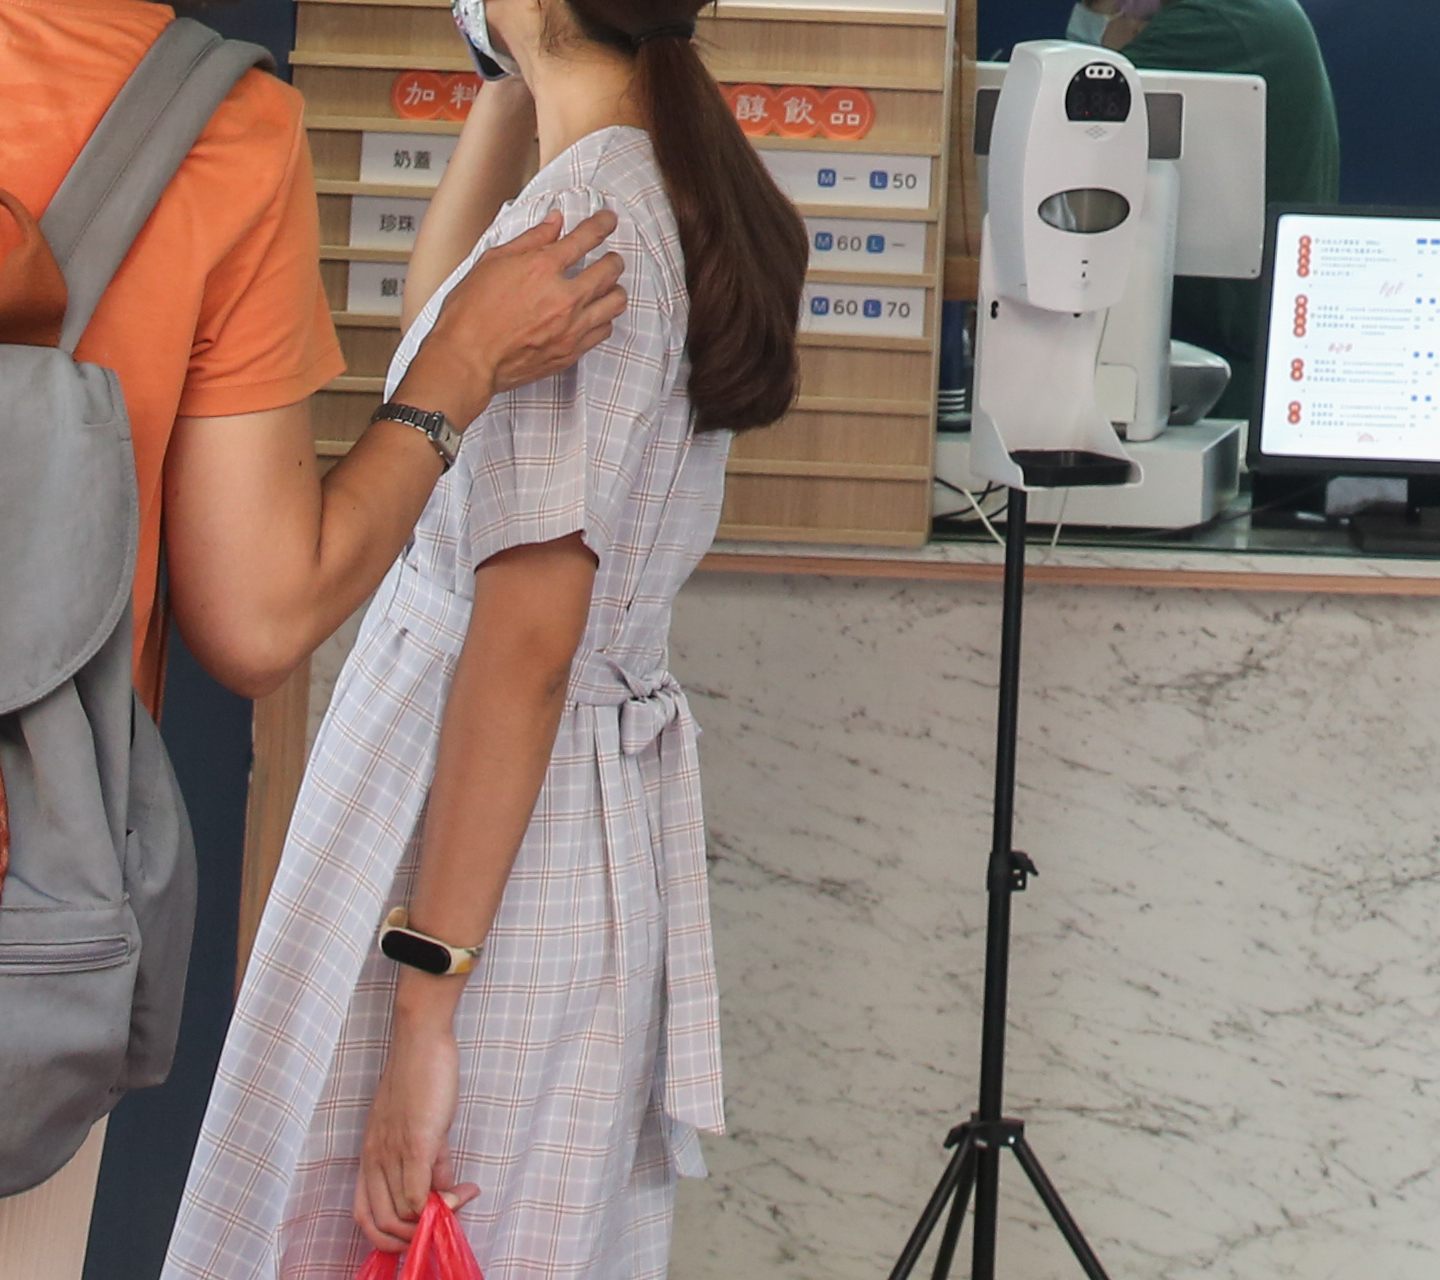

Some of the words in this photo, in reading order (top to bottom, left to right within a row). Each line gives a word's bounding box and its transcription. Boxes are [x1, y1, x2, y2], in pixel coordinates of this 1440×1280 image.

[404, 82, 478, 109] 加料
[393, 149, 431, 169] 奶蓋
[892, 173, 917, 189] 50
[379, 213, 415, 232] 珍珠
[836, 236, 862, 251] 60
[380, 276, 404, 297] 銀
[833, 299, 858, 316] 60
[887, 302, 910, 318] 70
